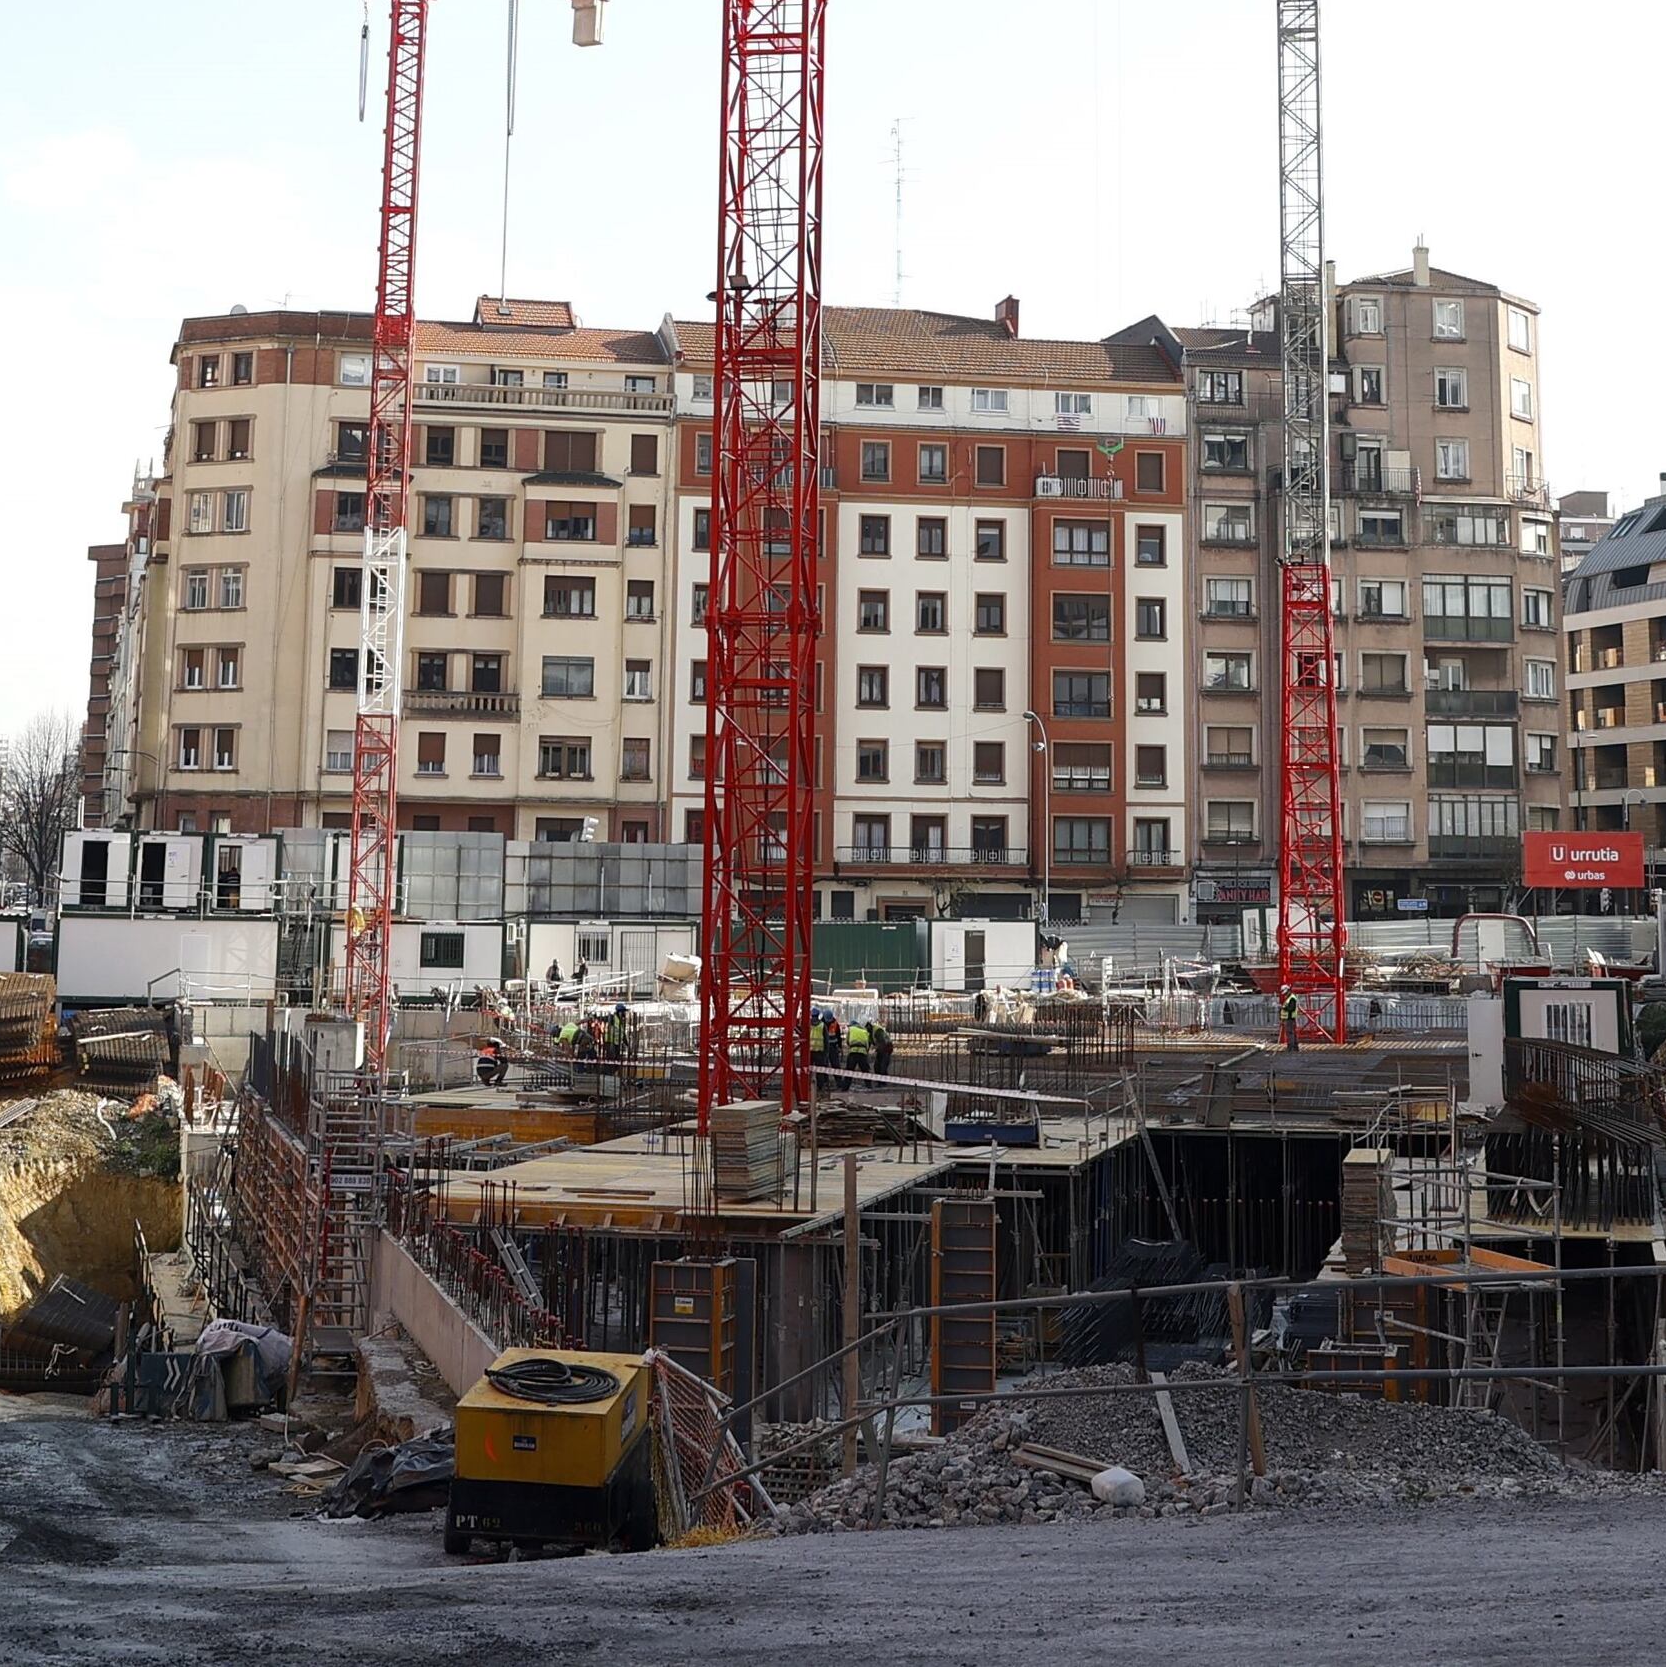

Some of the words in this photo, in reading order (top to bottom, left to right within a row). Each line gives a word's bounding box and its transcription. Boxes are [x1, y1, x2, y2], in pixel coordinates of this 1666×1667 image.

[1552, 846, 1564, 861] U
[1570, 846, 1619, 862] urrutia
[1577, 870, 1605, 880] urbas
[1249, 889, 1270, 902] HAIR
[456, 1514, 479, 1528] PT
